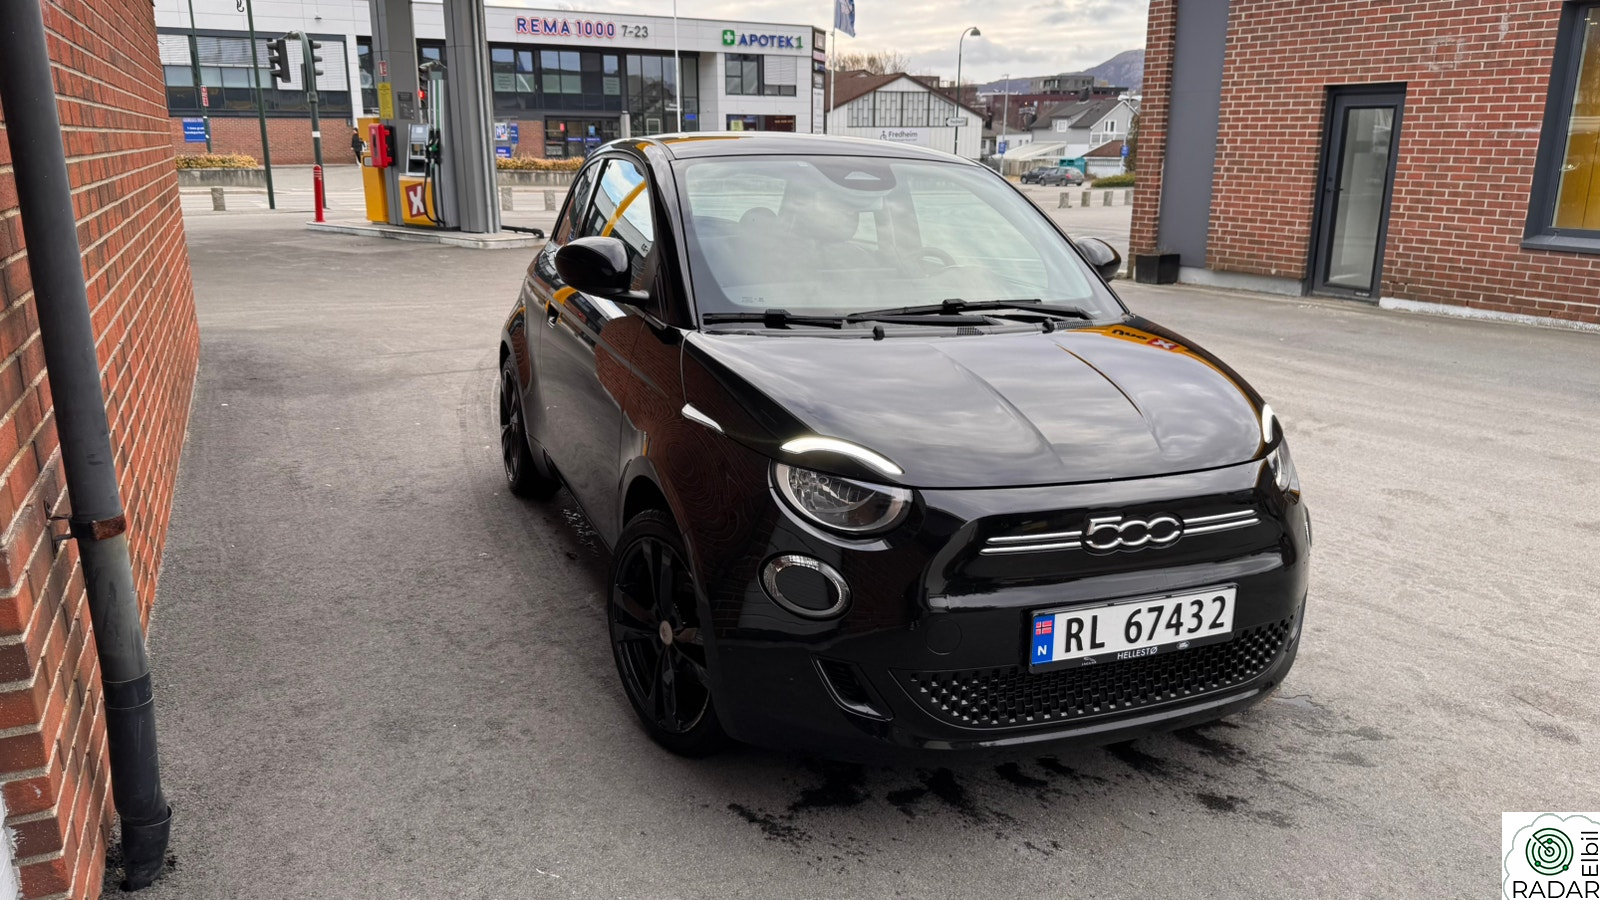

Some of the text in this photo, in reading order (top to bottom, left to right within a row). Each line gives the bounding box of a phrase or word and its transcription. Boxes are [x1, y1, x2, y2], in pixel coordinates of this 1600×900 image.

[516, 17, 649, 38] REMA 1000 7-23
[739, 33, 804, 48] APOTEK 1
[888, 130, 918, 138] Fredheim
[408, 185, 425, 215] X
[1085, 516, 1181, 549] 500
[1064, 595, 1227, 654] RL 67432
[1037, 644, 1048, 656] N
[1117, 646, 1158, 661] HELLESTØ
